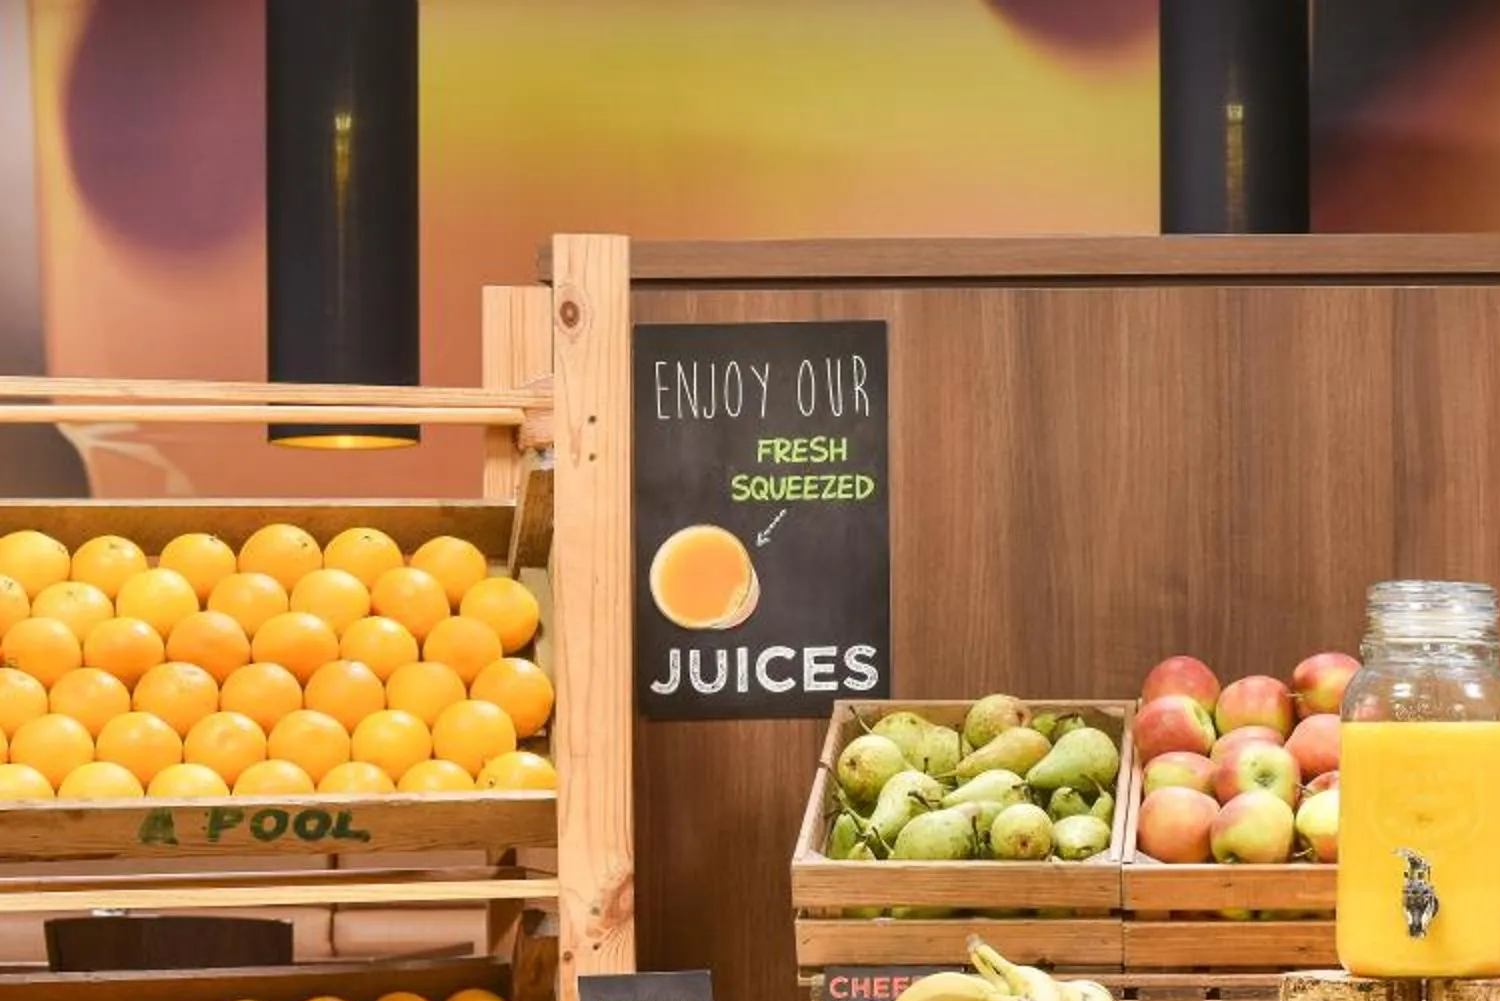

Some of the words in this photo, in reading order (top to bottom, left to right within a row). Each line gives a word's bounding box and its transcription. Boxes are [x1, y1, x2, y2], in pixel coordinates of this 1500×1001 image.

[655, 361, 770, 419] ENJOY
[798, 355, 870, 418] OUR
[757, 437, 848, 464] FRESH
[730, 474, 875, 503] SQUEEZED
[650, 645, 880, 695] JUICES
[206, 806, 371, 843] POOL
[829, 976, 912, 999] CHEE
